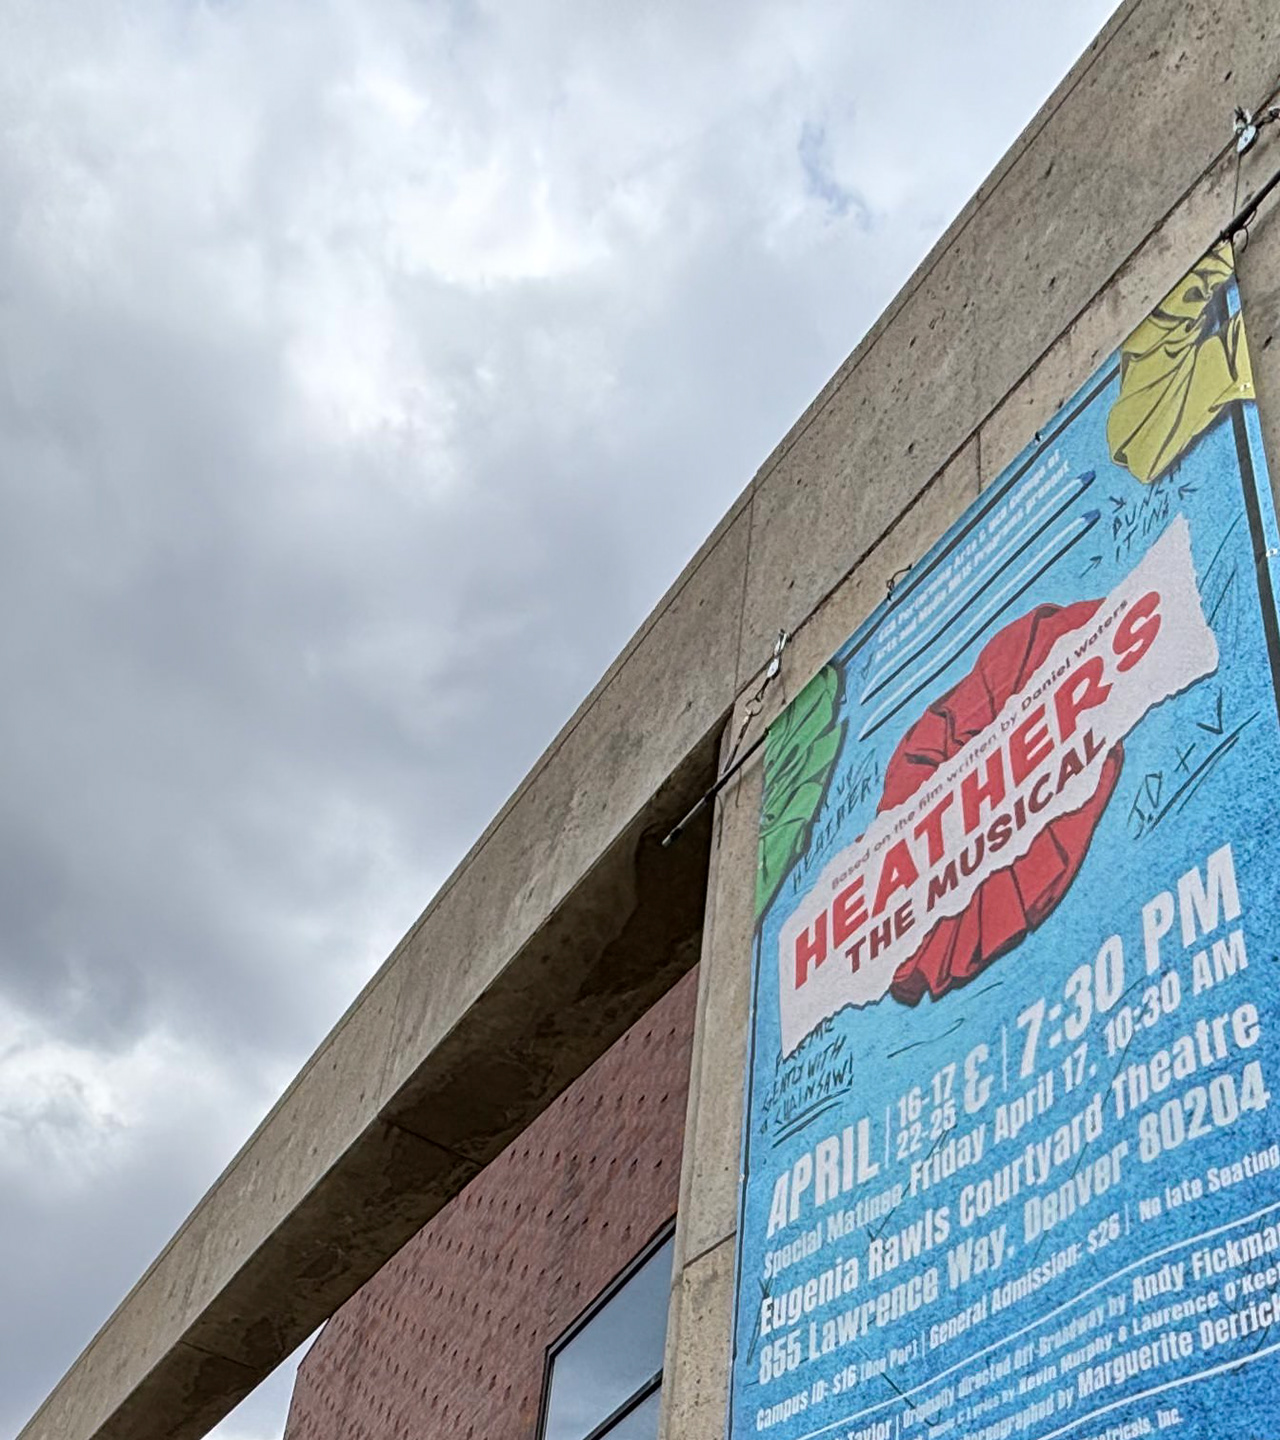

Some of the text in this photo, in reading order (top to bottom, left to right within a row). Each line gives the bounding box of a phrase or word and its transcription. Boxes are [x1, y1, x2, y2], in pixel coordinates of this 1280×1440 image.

[795, 585, 1164, 990] HEATHERS
[832, 597, 1127, 891] Based on the film written by Daniel Waters
[845, 723, 1106, 978] THE MUSICAL
[964, 1037, 992, 1118] &
[1017, 933, 1125, 1079] 7:30
[1141, 841, 1241, 975] PM
[763, 1221, 821, 1280] Special
[827, 1182, 902, 1243] Matinee
[910, 1122, 985, 1198] Friday
[994, 1069, 1054, 1146] April
[1104, 969, 1181, 1058] 10:30
[1192, 926, 1248, 997] AM
[896, 1097, 955, 1162] 22-25
[899, 1060, 955, 1128] 16-17
[758, 1326, 800, 1387] 855
[809, 1264, 937, 1361] Lawrence
[1023, 1139, 1127, 1244] Denver
[1138, 1059, 1270, 1166] 80204
[760, 998, 1261, 1337] Eugenia Rawls Courtyard Theatre
[765, 1114, 879, 1240] APRIL
[1139, 1142, 1279, 1222] No late Seating
[930, 1293, 987, 1350] General
[992, 1239, 1082, 1314] Admission:
[1019, 1364, 1056, 1395] Kevin
[1060, 1332, 1111, 1373] Murphy
[1133, 1290, 1218, 1336] Laurence
[1110, 1293, 1125, 1316] by
[1133, 1259, 1183, 1306] Andy
[757, 1388, 807, 1432] Campus
[811, 1378, 827, 1405] ID:
[1057, 1386, 1073, 1409] by
[1078, 1330, 1193, 1398] Marguerite
[1157, 1406, 1183, 1428] Inc.
